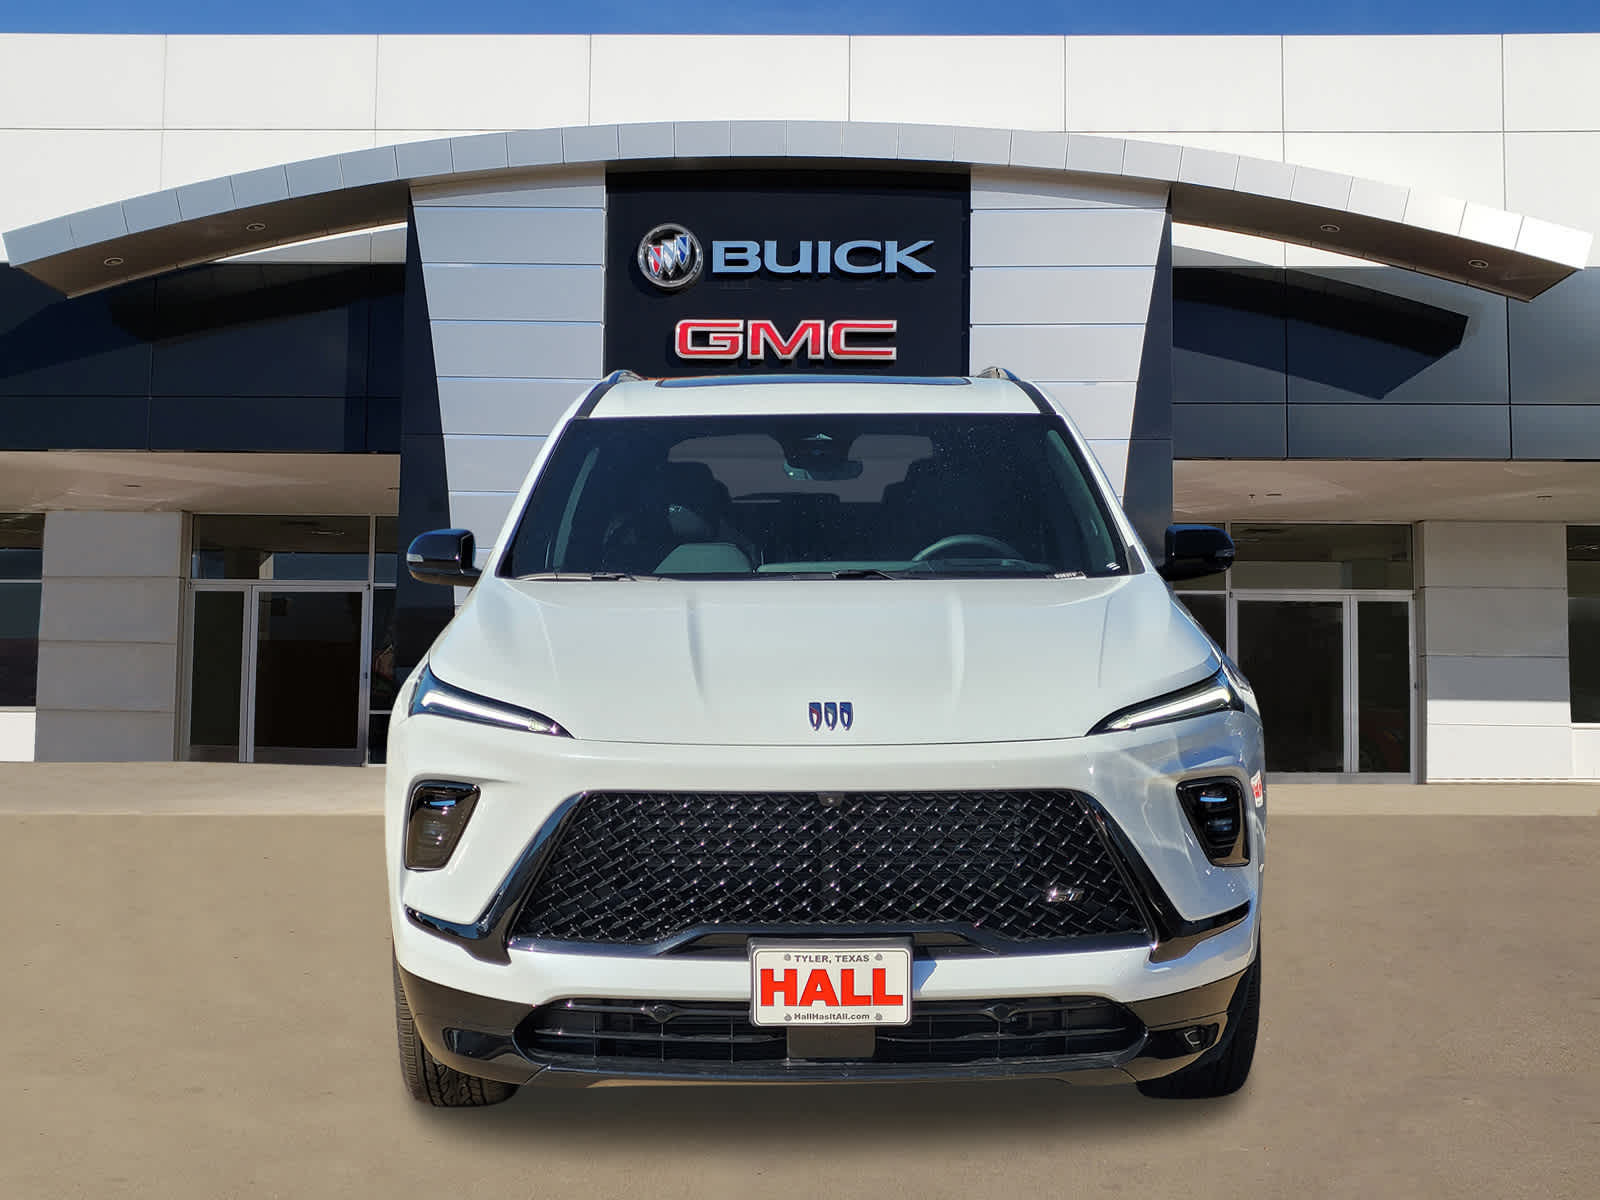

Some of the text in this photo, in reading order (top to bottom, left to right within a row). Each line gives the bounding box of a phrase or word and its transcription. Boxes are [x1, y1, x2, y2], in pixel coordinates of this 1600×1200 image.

[712, 240, 936, 273] BUICK
[675, 319, 897, 361] GMC
[794, 954, 870, 964] TYLER, TEXAS
[760, 968, 904, 1007] HALL
